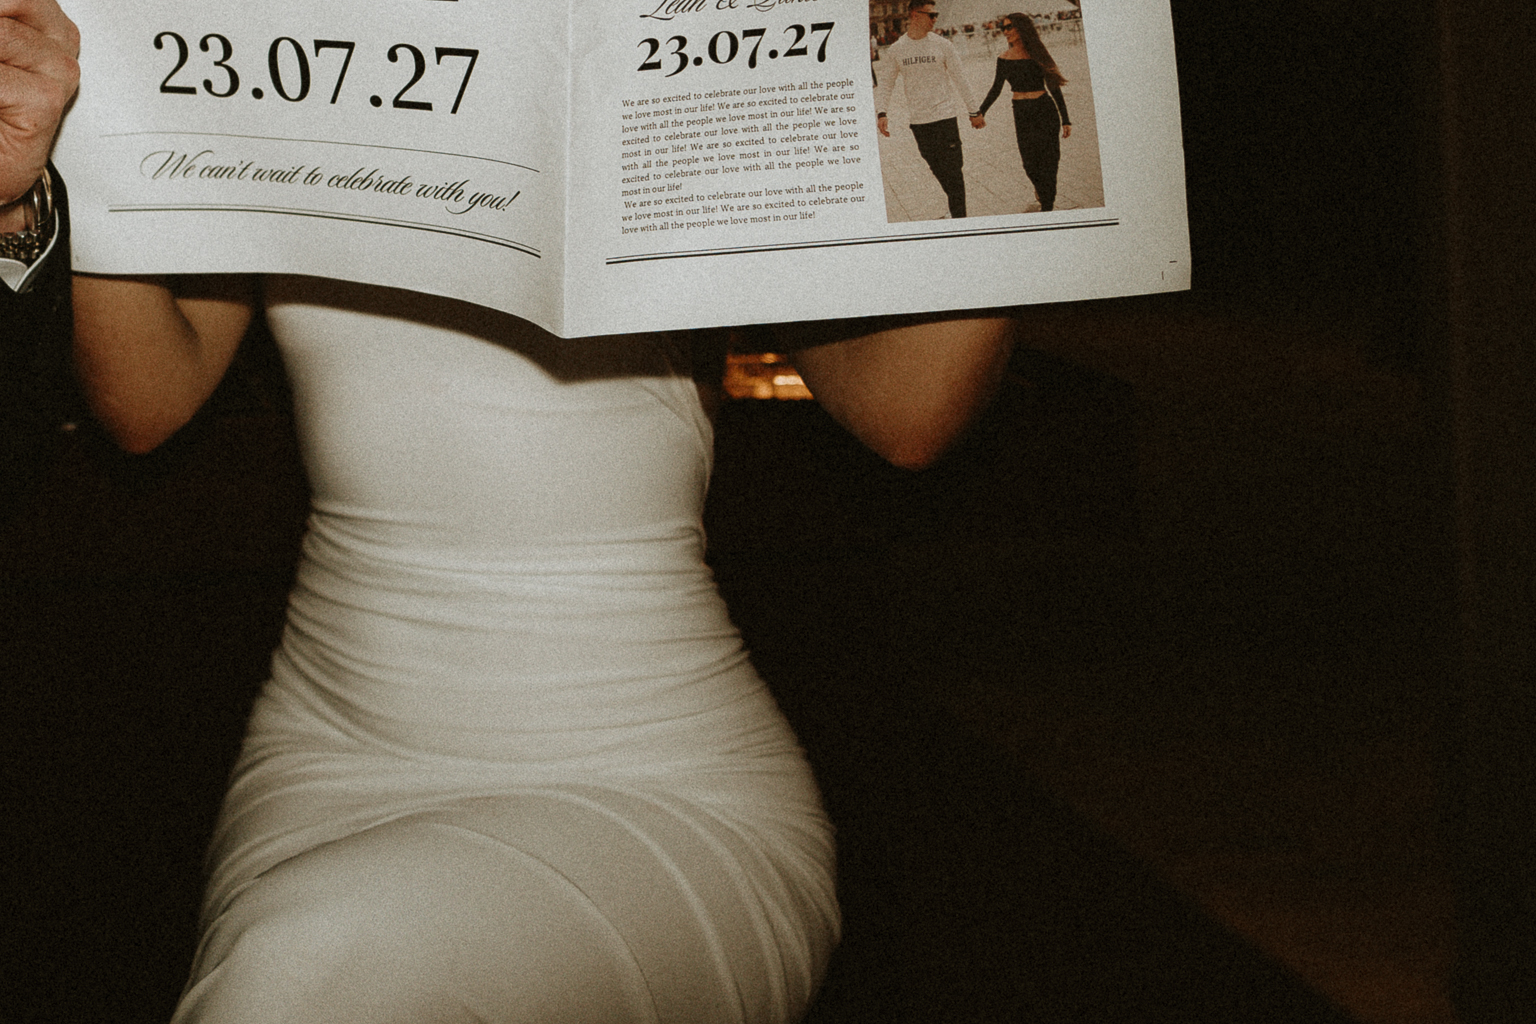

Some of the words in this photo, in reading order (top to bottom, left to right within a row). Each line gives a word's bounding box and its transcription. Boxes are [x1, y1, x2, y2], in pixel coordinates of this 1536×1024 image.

[636, 21, 835, 78] 23.07.27
[902, 56, 937, 66] HILFIGER
[153, 31, 479, 115] 23.07.27
[621, 99, 635, 108] We
[636, 98, 650, 107] are
[651, 97, 661, 105] so
[662, 91, 692, 103] excited
[693, 92, 703, 101] to
[703, 88, 742, 100] celebrate
[742, 87, 758, 95] our
[758, 85, 777, 94] love
[777, 82, 797, 92] with
[797, 80, 809, 91] all
[809, 80, 824, 90] the
[825, 77, 854, 91] people
[621, 113, 634, 121] we
[634, 110, 652, 120] love
[652, 107, 673, 118] most
[674, 107, 683, 116] in
[683, 106, 699, 114] our
[699, 102, 716, 112] life!
[716, 101, 731, 111] We
[732, 101, 745, 110] are
[746, 100, 757, 108] so
[757, 95, 788, 107] excited
[789, 96, 799, 104] to
[799, 92, 839, 103] celebrate
[839, 92, 855, 101] our
[140, 150, 214, 180] We
[199, 161, 254, 180] can't
[252, 166, 300, 184] wait
[303, 166, 323, 186] to
[328, 167, 413, 196] celebrate
[415, 179, 469, 203] with
[445, 190, 521, 215] you!
[621, 187, 642, 197] most
[642, 187, 651, 195] in
[651, 185, 666, 194] our
[666, 182, 683, 192] life!
[621, 214, 633, 222] we
[634, 212, 652, 221] love
[652, 209, 674, 219] most
[675, 208, 684, 217] in
[685, 207, 700, 216] our
[701, 205, 718, 215] life!
[719, 204, 735, 213] We
[736, 204, 751, 212] are
[752, 203, 763, 211] so
[763, 198, 796, 210] excited
[796, 199, 807, 208] to
[808, 195, 849, 207] celebrate
[849, 195, 865, 203] our
